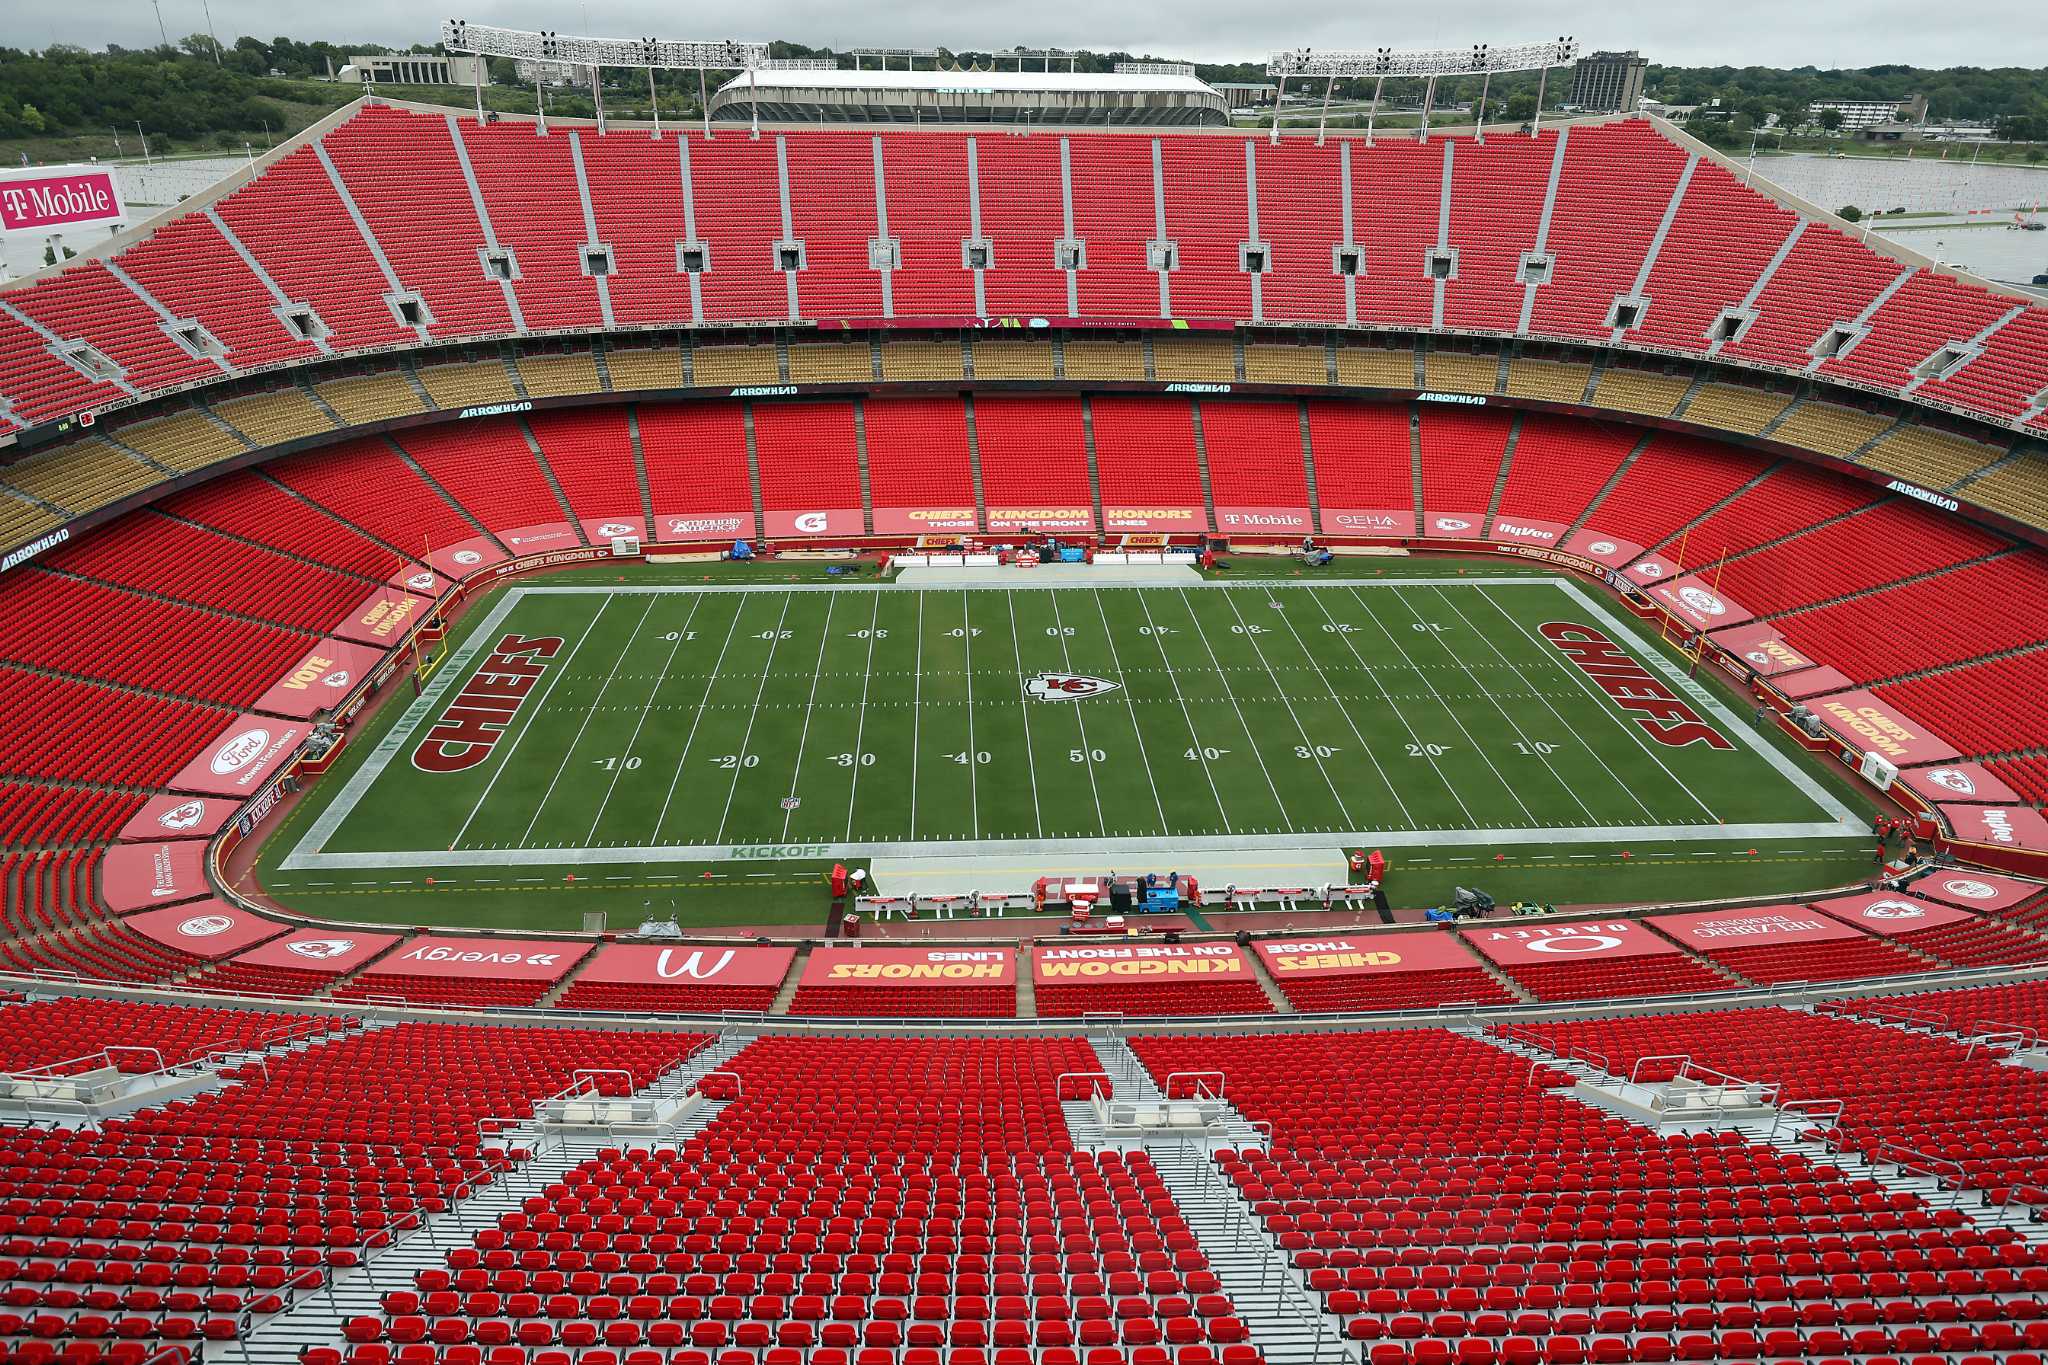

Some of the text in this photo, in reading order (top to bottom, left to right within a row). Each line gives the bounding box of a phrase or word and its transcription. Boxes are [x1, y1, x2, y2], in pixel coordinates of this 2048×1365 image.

[3, 183, 110, 220] T Mobile
[484, 333, 509, 341] CHERRY
[313, 353, 345, 362] HEADRICK
[1655, 348, 1682, 357] SHIELDS
[1762, 364, 1787, 374] HOLMES
[206, 374, 231, 385] HAYNES
[1814, 374, 1836, 384] GREEN
[161, 385, 182, 396] LYNCH
[730, 386, 798, 396] ARROWHEAD
[1164, 383, 1231, 393] ARROWHEAD
[1861, 384, 1900, 398] RICHARDSON
[111, 396, 139, 410] PODOLAK
[1417, 392, 1487, 405] ARROWHEAD
[1926, 399, 1953, 412] CARSON
[458, 401, 532, 419] ARROWHEAD
[1977, 413, 2012, 428] GONZALEZ
[1886, 481, 1958, 512] ARROWHEAD
[908, 510, 974, 520] CHIEFS
[988, 510, 1089, 520] KINGDOM
[1107, 510, 1193, 519] HONORS
[1224, 514, 1304, 525] T Mobile
[668, 517, 744, 528] Community
[926, 537, 957, 545] CHIEFS
[1129, 536, 1160, 545] CHIEFS
[0, 528, 69, 573] ARROWHEAD
[496, 567, 508, 575] THIS
[515, 557, 545, 570] CHIEFS
[545, 550, 595, 564] KINGDOM
[1518, 547, 1549, 560] CHIEFS
[1549, 552, 1594, 572] KINGDOM
[360, 600, 395, 626] CHIEFS
[370, 598, 420, 637] KINGDOM
[1758, 640, 1807, 666] VOTE
[282, 655, 334, 690] VOTE
[1644, 650, 1672, 670] END
[1667, 669, 1722, 709] RACISM
[1536, 621, 1738, 752] CHIEFS
[391, 700, 430, 736] TAKES
[423, 678, 451, 697] ALL
[411, 633, 565, 773] CHIEFS
[1823, 702, 1909, 756] KINGDOM
[1856, 706, 1918, 741] CHIEFS
[1183, 747, 1221, 760] 40
[1293, 745, 1333, 759] 30
[1404, 743, 1443, 757] 20
[1512, 741, 1553, 755] 10
[717, 754, 760, 768] 20
[835, 753, 876, 767] 30
[953, 751, 992, 764] 40
[1069, 749, 1107, 762] 50
[602, 756, 642, 771] 10
[251, 791, 275, 823] KICKOFF
[730, 845, 831, 859] KICKOFF
[1490, 923, 1629, 941] OAKLEY
[1692, 920, 1827, 938] HELZBERG
[1041, 945, 1233, 960] ON THE FRONT
[1265, 940, 1356, 954] THOSE
[402, 945, 518, 964] evergy
[927, 951, 1004, 961] LINES
[1276, 951, 1402, 972] CHIEFS
[828, 963, 1004, 978] HONORS
[1040, 957, 1241, 978] KINGDOM
